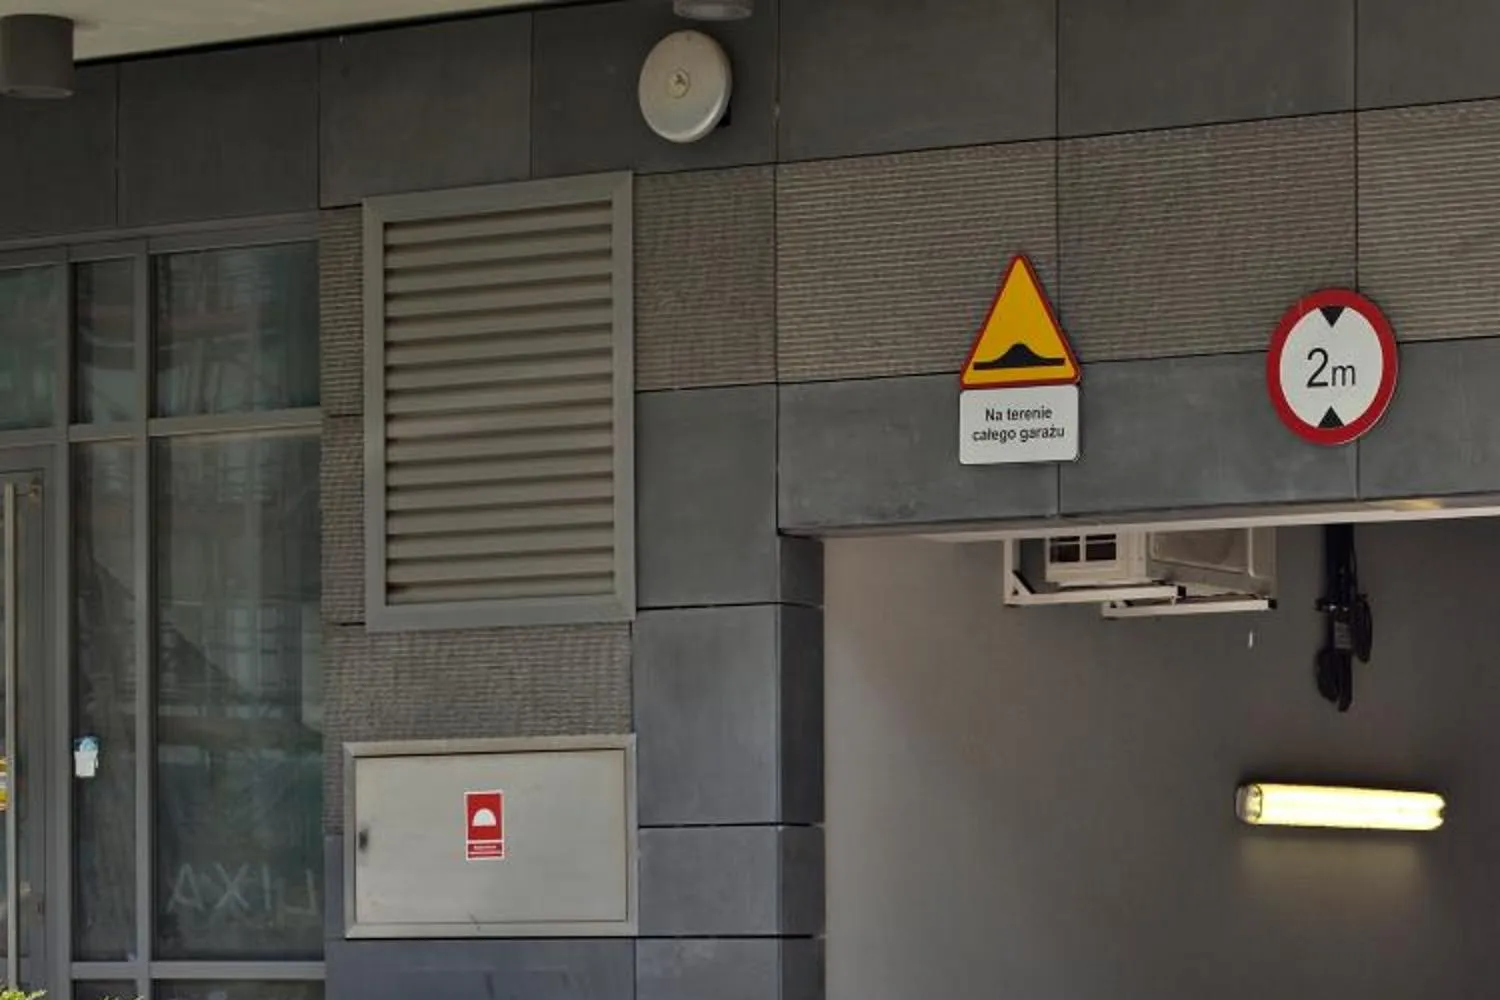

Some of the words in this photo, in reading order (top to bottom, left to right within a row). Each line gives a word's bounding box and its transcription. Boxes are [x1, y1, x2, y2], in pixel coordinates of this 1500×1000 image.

[1307, 347, 1356, 388] 2m
[985, 407, 1003, 421] Na
[1007, 405, 1053, 421] terenie
[1019, 424, 1065, 443] garażu
